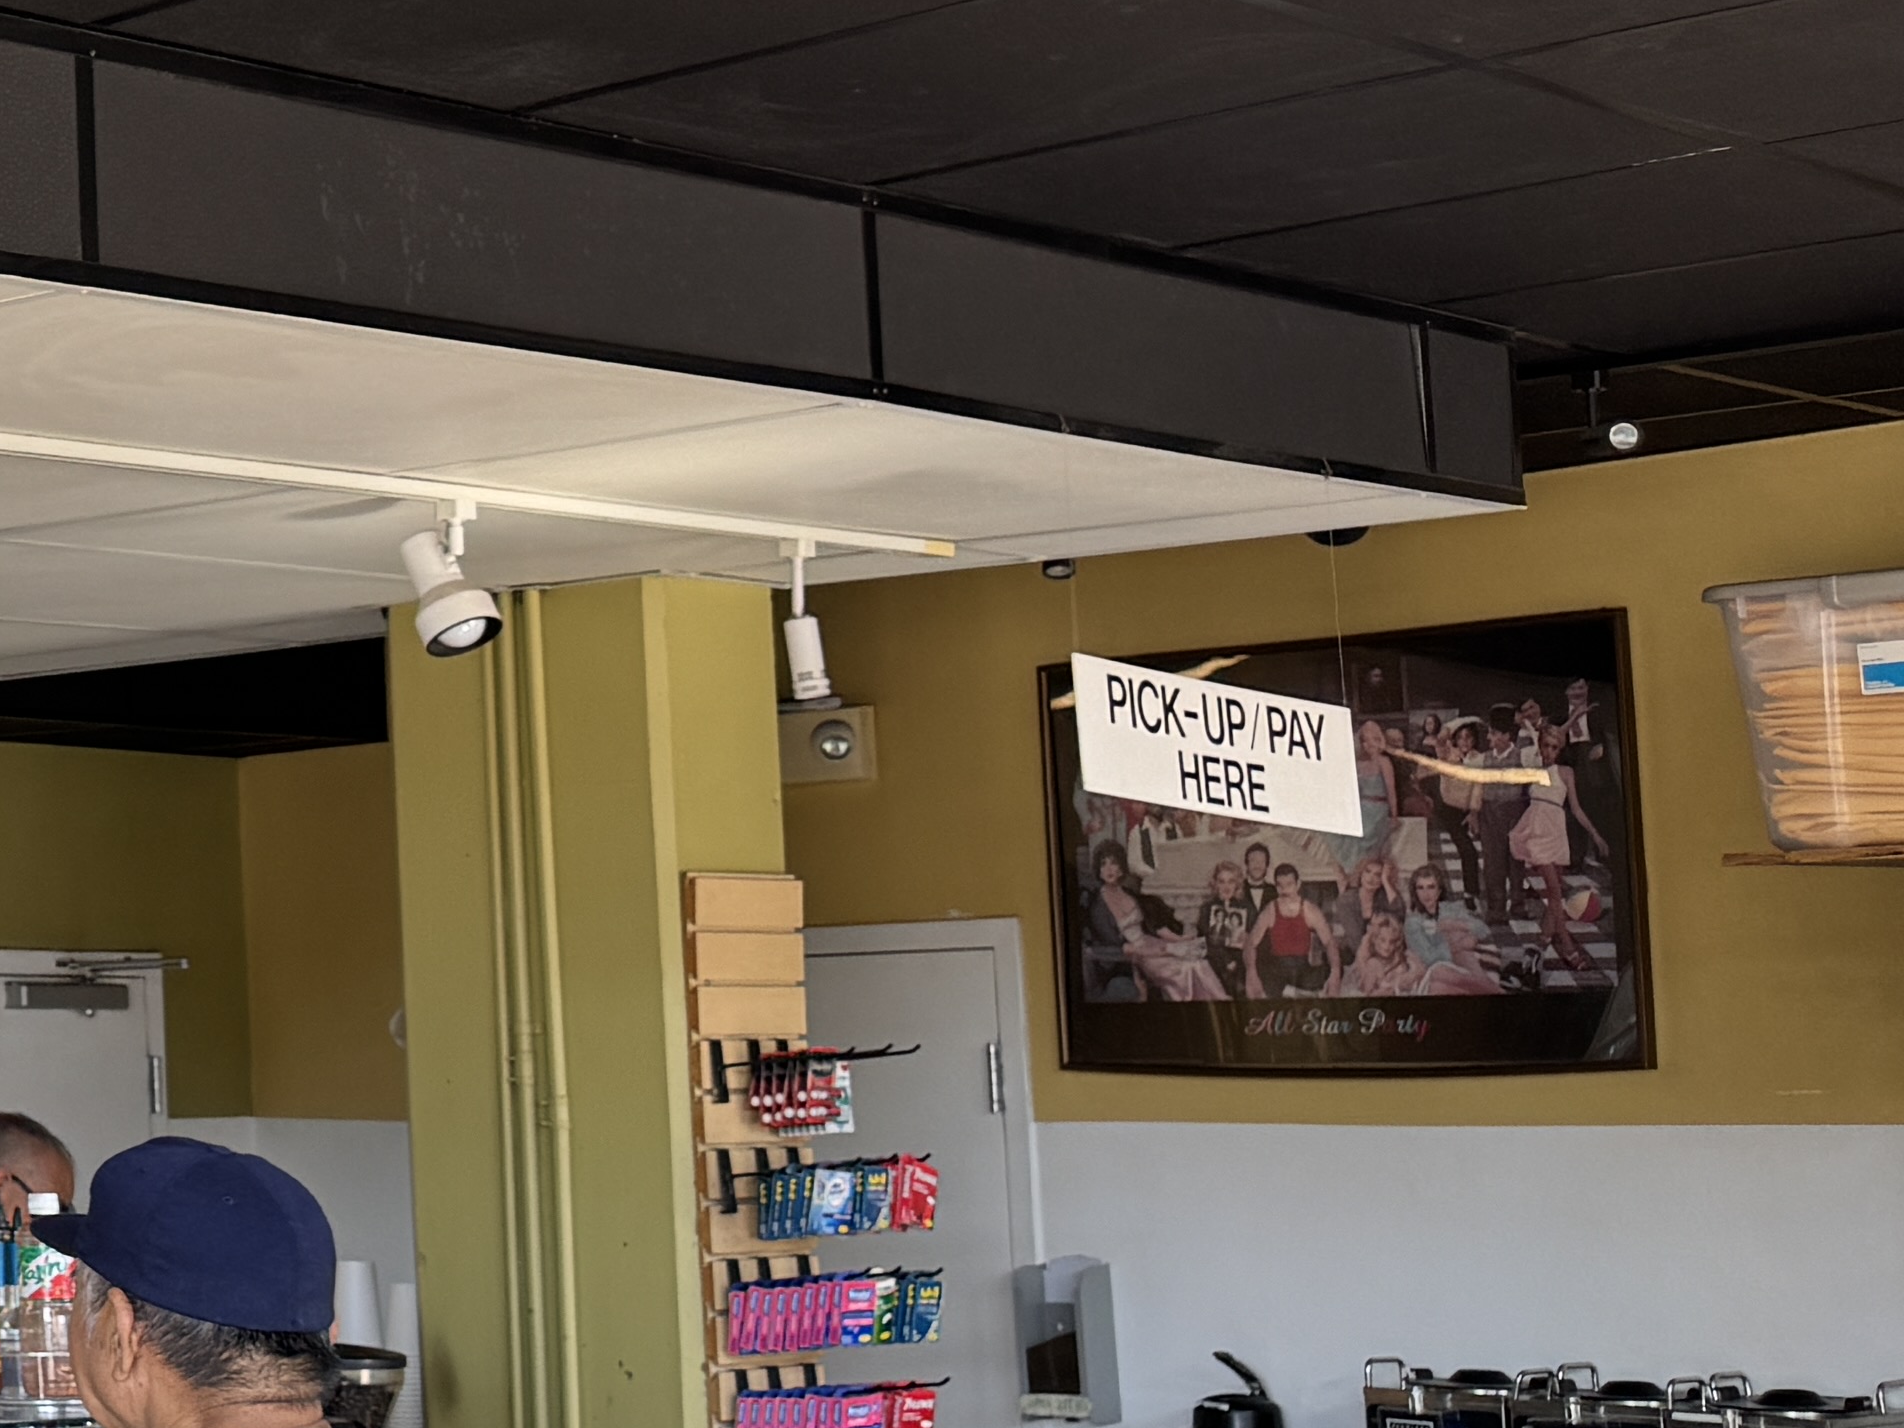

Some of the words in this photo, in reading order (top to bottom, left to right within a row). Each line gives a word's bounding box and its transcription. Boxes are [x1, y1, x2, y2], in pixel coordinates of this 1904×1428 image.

[1178, 750, 1270, 814] HERE
[1302, 1009, 1352, 1035] Star
[1359, 1008, 1429, 1042] Prty
